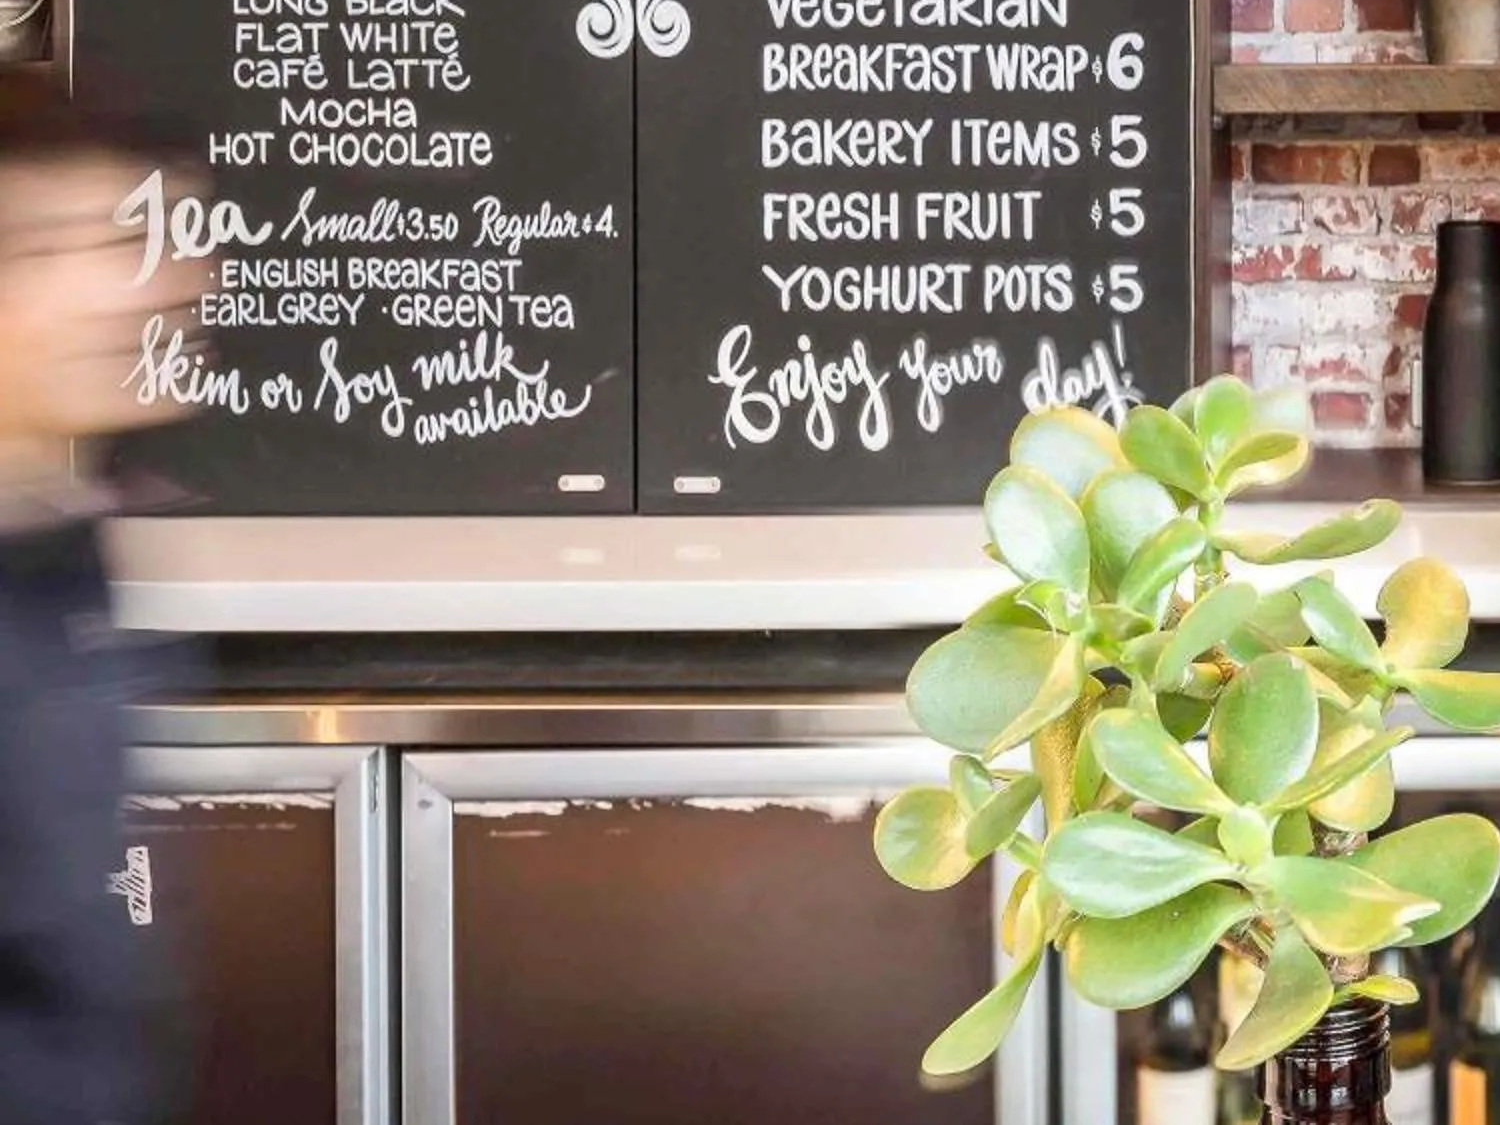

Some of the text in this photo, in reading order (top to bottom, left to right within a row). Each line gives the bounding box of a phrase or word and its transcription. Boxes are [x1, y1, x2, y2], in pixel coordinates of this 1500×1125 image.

[1091, 32, 1146, 91] $6
[209, 133, 274, 166] HOT
[1090, 114, 1149, 168] $5
[281, 187, 400, 246] Small
[472, 195, 579, 255] Regular
[916, 190, 1042, 241] FRUIT
[1090, 188, 1146, 237] $5
[221, 258, 339, 288] ENGLISH
[762, 262, 1145, 313] YOGHURT POTS $5
[121, 316, 249, 415] Skim
[260, 378, 302, 412] or
[412, 330, 548, 392] milk
[707, 324, 890, 451] Enjoy
[899, 338, 1004, 433] your
[414, 381, 592, 445] available
